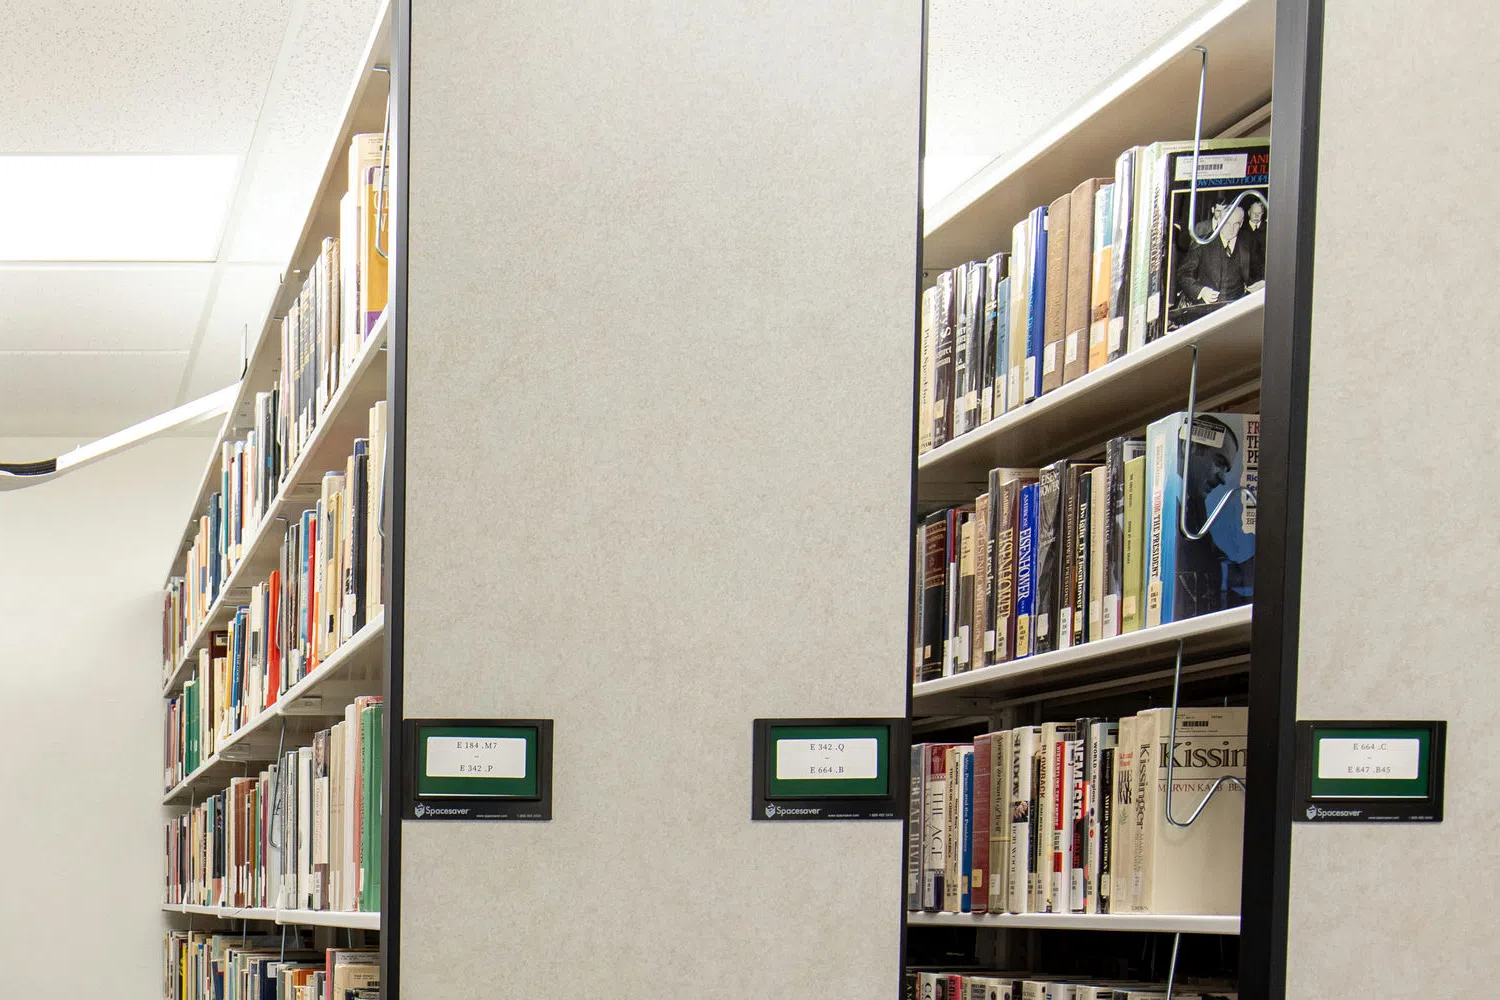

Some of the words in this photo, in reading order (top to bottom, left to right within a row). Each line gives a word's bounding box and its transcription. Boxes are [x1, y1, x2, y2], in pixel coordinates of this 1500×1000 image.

[1018, 528, 1032, 600] EISENHOWER
[1152, 534, 1160, 578] PRESIDENT
[1136, 744, 1150, 829] Kissinger
[426, 806, 469, 816] Spacesaver
[776, 807, 820, 816] Spacesaver
[932, 792, 944, 816] THE
[1317, 809, 1362, 818] Spacesaver
[931, 824, 943, 860] AGE
